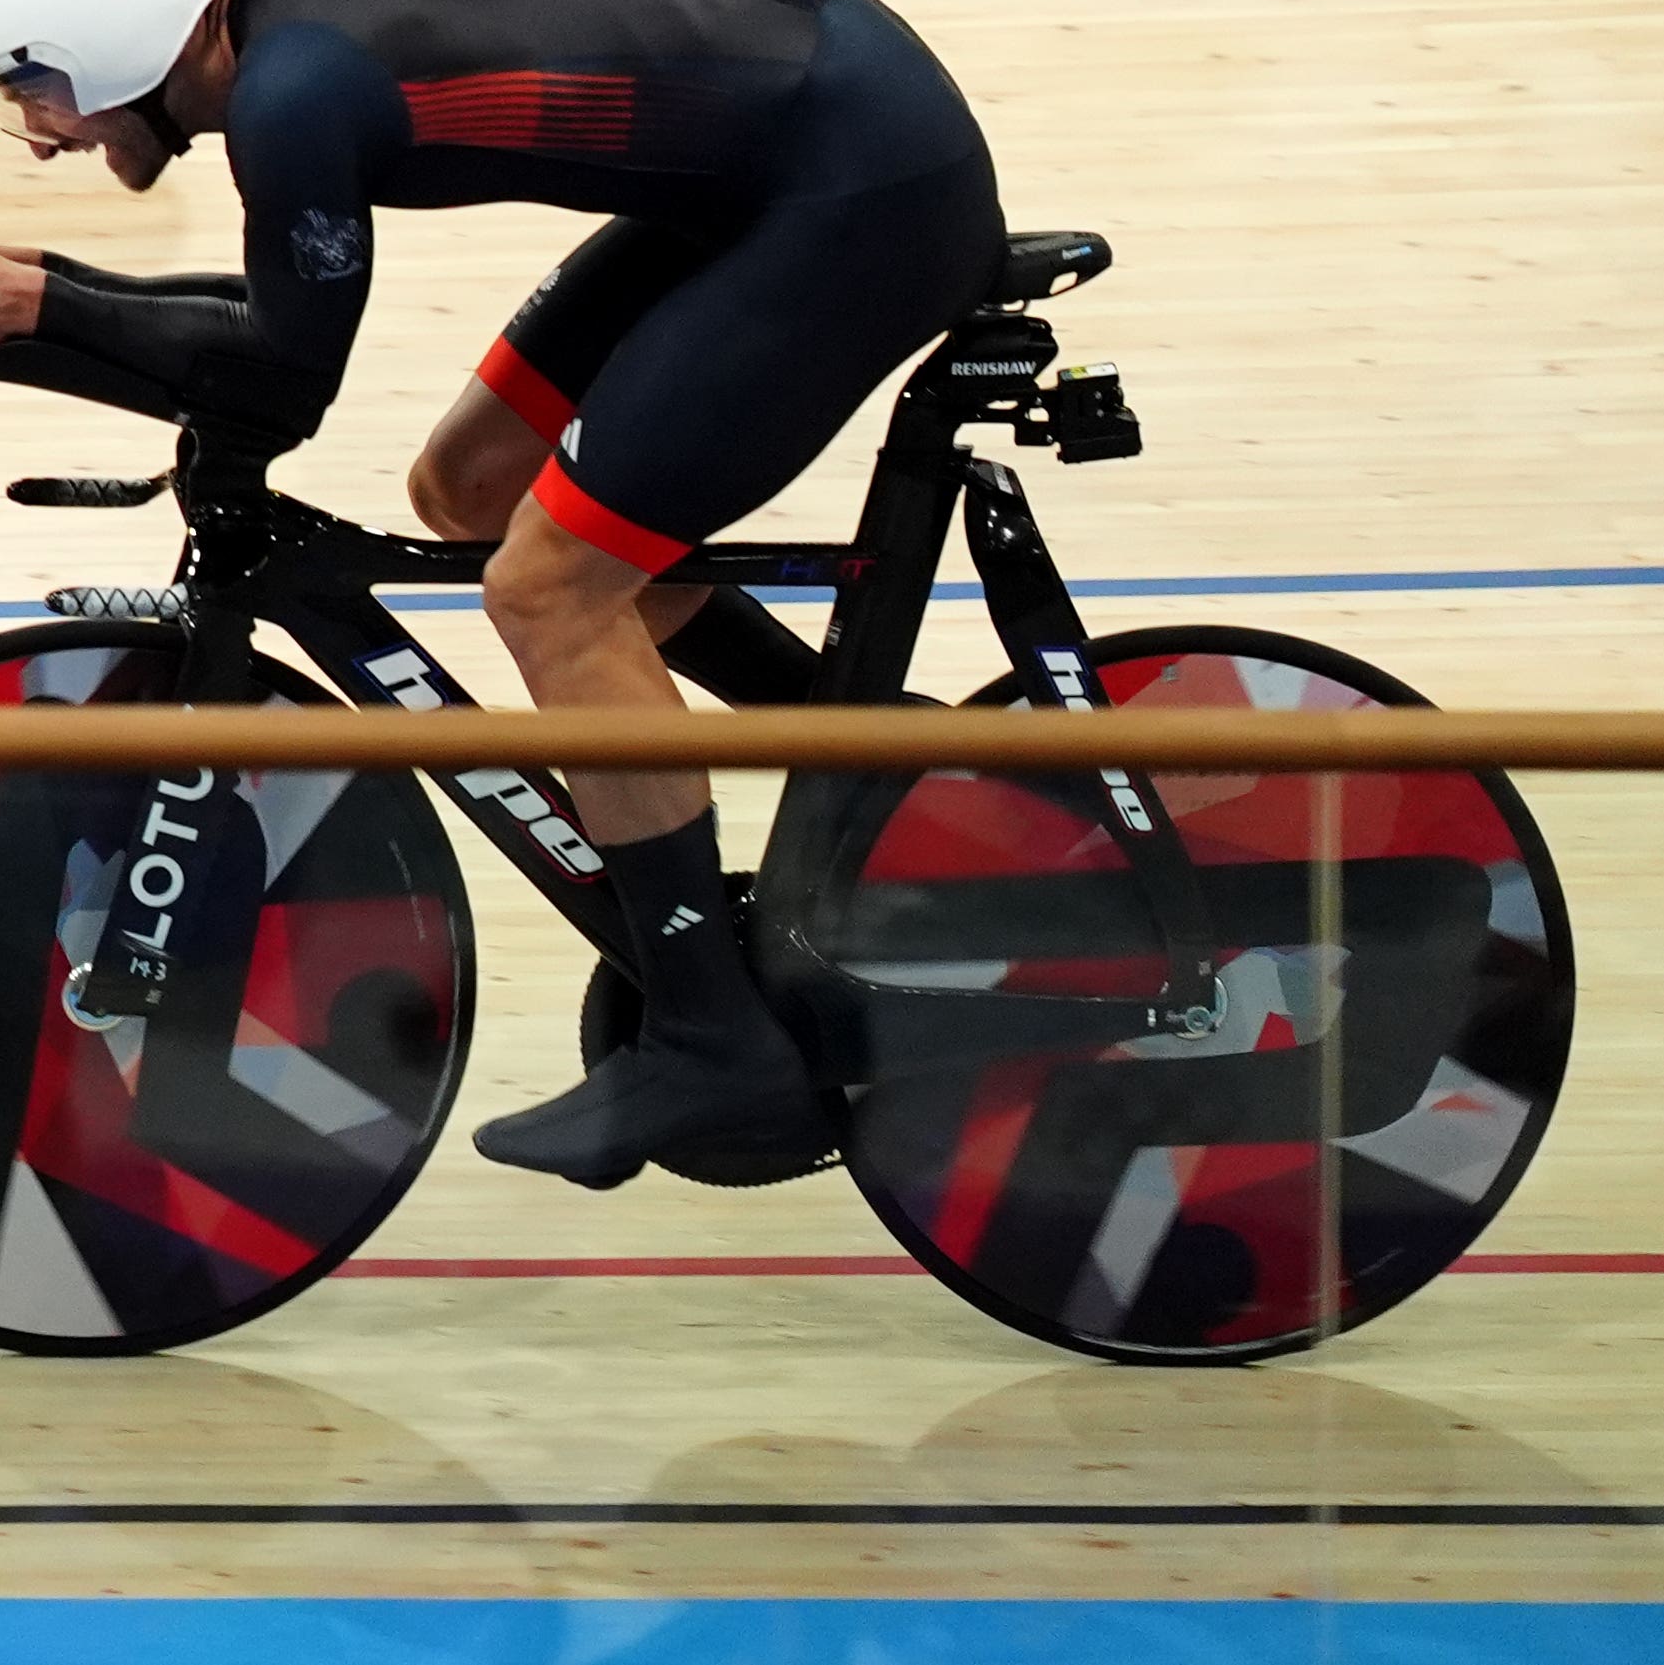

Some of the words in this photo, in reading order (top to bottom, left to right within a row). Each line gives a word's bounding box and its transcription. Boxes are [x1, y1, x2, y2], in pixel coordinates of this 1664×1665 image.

[951, 361, 1036, 376] RENISHAW
[363, 647, 605, 877] hpe
[1040, 651, 1154, 832] he
[121, 766, 216, 950] LOTU
